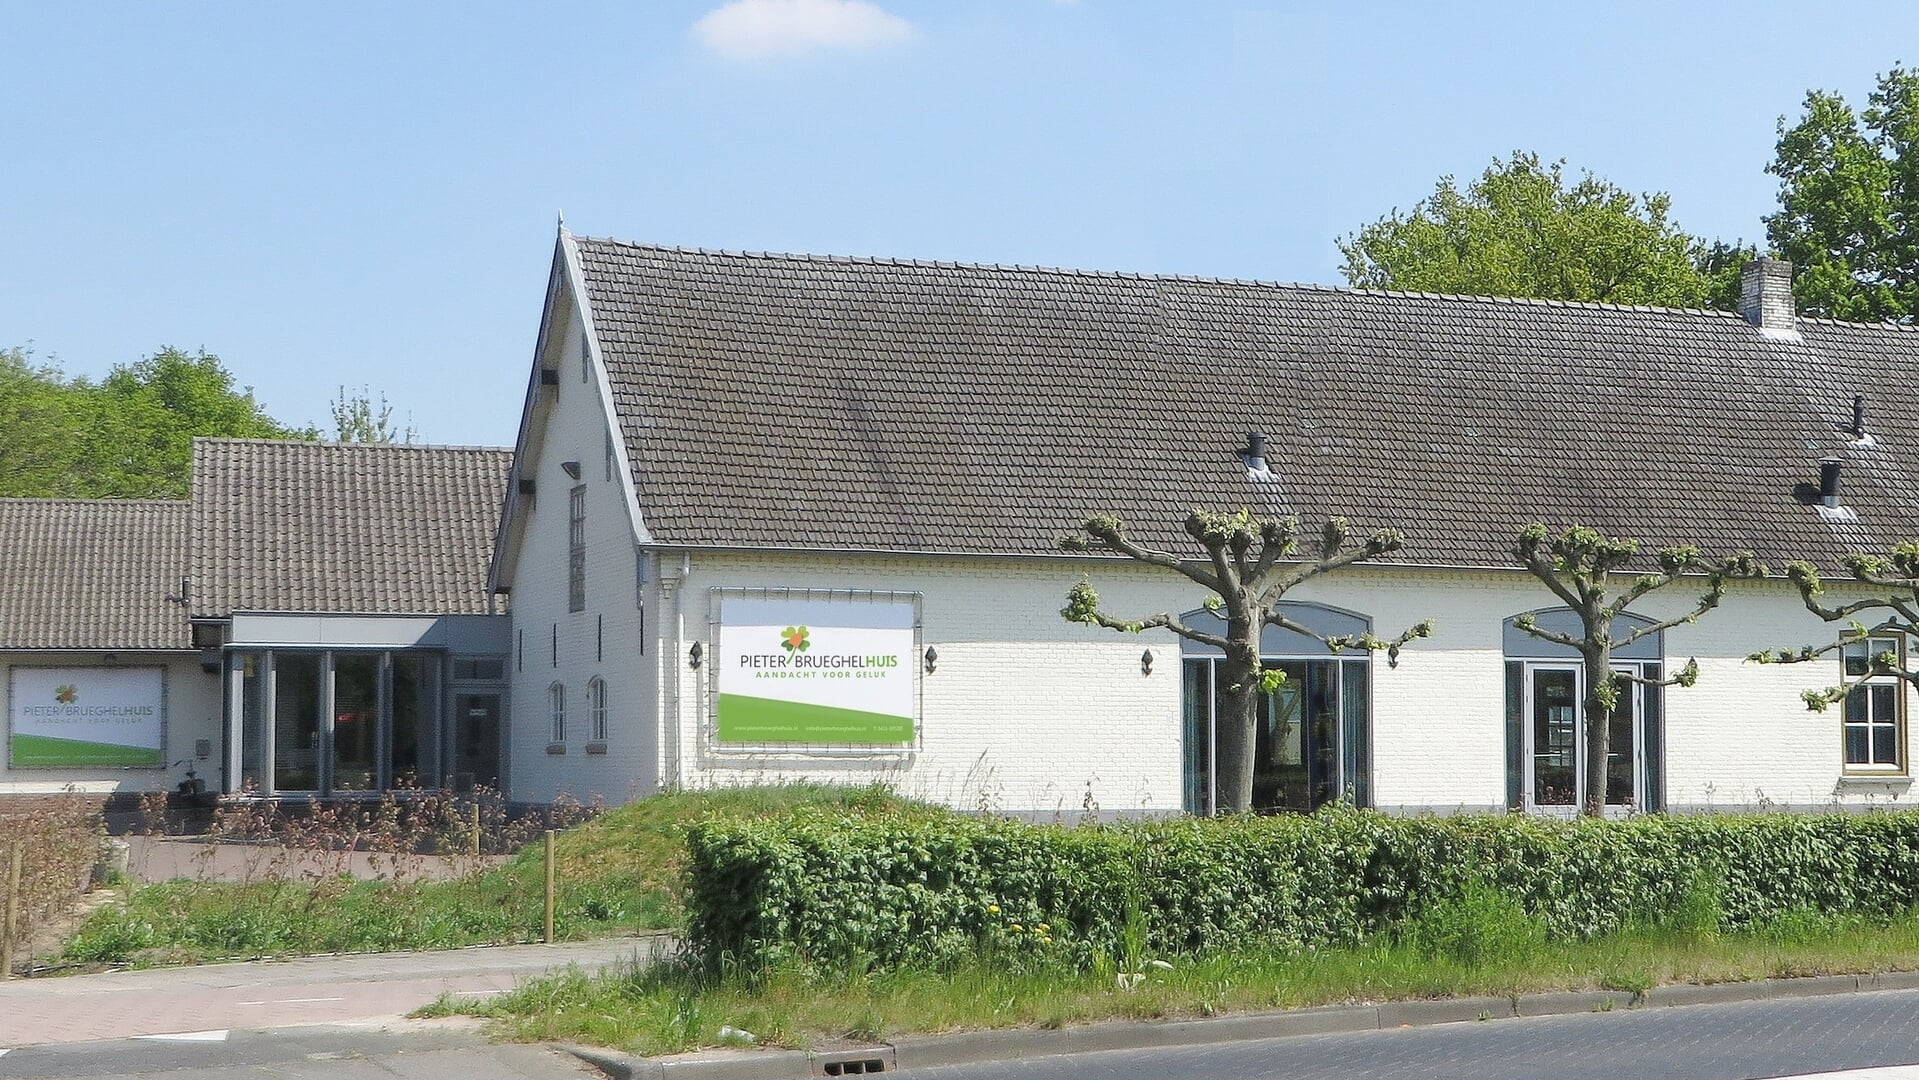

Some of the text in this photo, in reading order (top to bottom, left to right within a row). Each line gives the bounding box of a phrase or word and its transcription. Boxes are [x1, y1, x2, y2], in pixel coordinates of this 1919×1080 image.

[740, 655, 898, 668] PIETER BRUEGHELHUIS
[755, 671, 887, 679] AANDACHT VOOR GELUK
[23, 705, 153, 717] PIETER BRUEGHELHUIS
